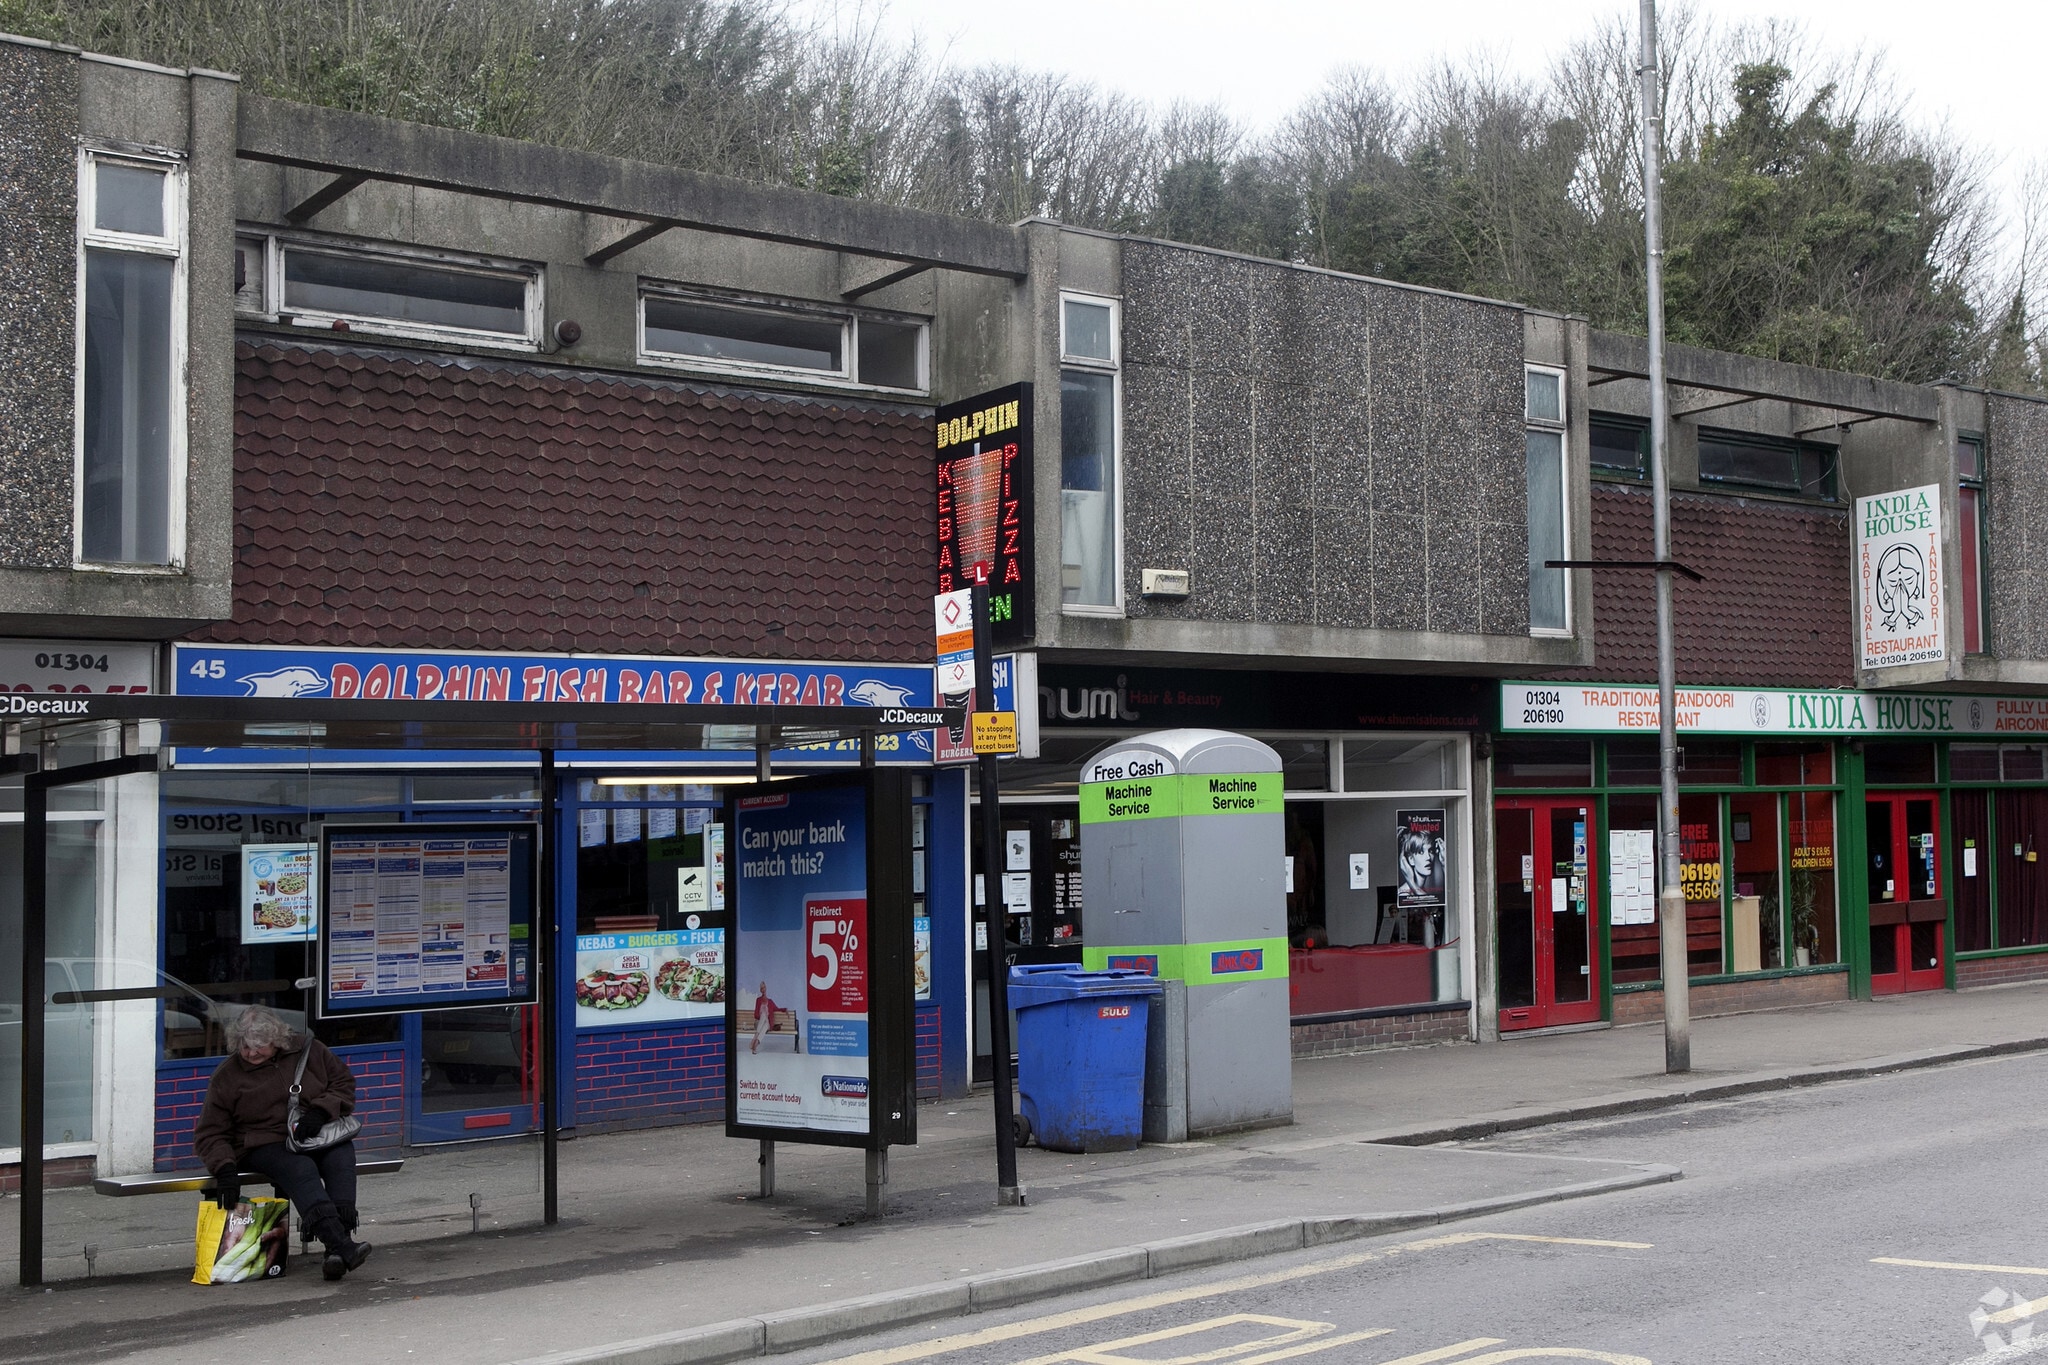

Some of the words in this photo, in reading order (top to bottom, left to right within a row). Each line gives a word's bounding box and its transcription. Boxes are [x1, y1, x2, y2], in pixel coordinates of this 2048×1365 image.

[936, 400, 1019, 449] DOLPHIN
[1002, 442, 1021, 584] PIZZA
[1866, 492, 1930, 519] INDIA
[937, 459, 954, 595] KEBAB
[1864, 510, 1933, 538] HOUSE
[976, 565, 986, 581] L
[1929, 533, 1939, 632] TANDOORI
[1862, 543, 1873, 640] TRADITIONAL
[1866, 634, 1938, 655] RESTAURANT
[35, 653, 109, 673] 01304
[1865, 658, 1879, 667] Tel:
[1880, 655, 1907, 665] 01304
[1910, 650, 1942, 661] 206190
[190, 659, 226, 680] 45
[331, 663, 511, 700] DOLPHIN
[523, 665, 607, 702] FISH
[618, 668, 693, 704] BAR
[733, 673, 845, 706] KEBAB
[1037, 674, 1140, 721] umi
[1130, 690, 1160, 705] Hair
[1162, 690, 1174, 705] &
[1177, 691, 1222, 710] Beauty
[1526, 691, 1560, 706] 01304
[1582, 690, 1661, 707] TRADITIONA
[1787, 694, 1867, 730] INDIA
[1875, 696, 1954, 731] HOUSE
[1996, 700, 2034, 715] FULLY
[879, 709, 944, 724] JCDecaux
[1358, 713, 1480, 727] www.shumisalons.co.uk
[1523, 710, 1564, 723] 206190
[1618, 711, 1701, 727] RESTAANT
[976, 726, 986, 734] No
[986, 724, 1013, 734] stopping
[975, 742, 996, 750] except
[997, 740, 1015, 749] buses
[986, 734, 997, 742] any
[940, 746, 974, 759] BURGERS
[1094, 765, 1124, 781] Free
[1128, 759, 1164, 777] Cash
[1106, 783, 1152, 800] Machine
[1209, 779, 1257, 793] Machine
[1108, 802, 1150, 817] Service
[1212, 796, 1255, 809] Service
[1410, 822, 1440, 832] Wanted
[1681, 823, 1709, 840] FREE
[742, 826, 769, 850] Can
[772, 826, 806, 855] your
[808, 819, 846, 843] bank
[1680, 842, 1720, 859] ELIVERY
[743, 852, 787, 878] match
[790, 850, 825, 875] this?
[1791, 858, 1818, 868] CHILDREN
[810, 905, 842, 917] FlexDirect
[578, 936, 616, 950] KEBAB
[628, 933, 678, 947] BURGERS
[691, 931, 714, 944] FISH
[623, 955, 640, 963] SHISH
[696, 950, 718, 959] CHICKEN
[840, 951, 854, 963] AER
[622, 961, 641, 969] KEBAB
[739, 1080, 759, 1090] Switch
[760, 1081, 766, 1090] to
[768, 1083, 777, 1091] our
[832, 1080, 867, 1093] Nationwide
[740, 1091, 761, 1100] current
[762, 1092, 784, 1102] account
[785, 1093, 802, 1105] today
[841, 1098, 848, 1106] On
[891, 1111, 901, 1120] 29
[229, 1210, 255, 1232] fresh
